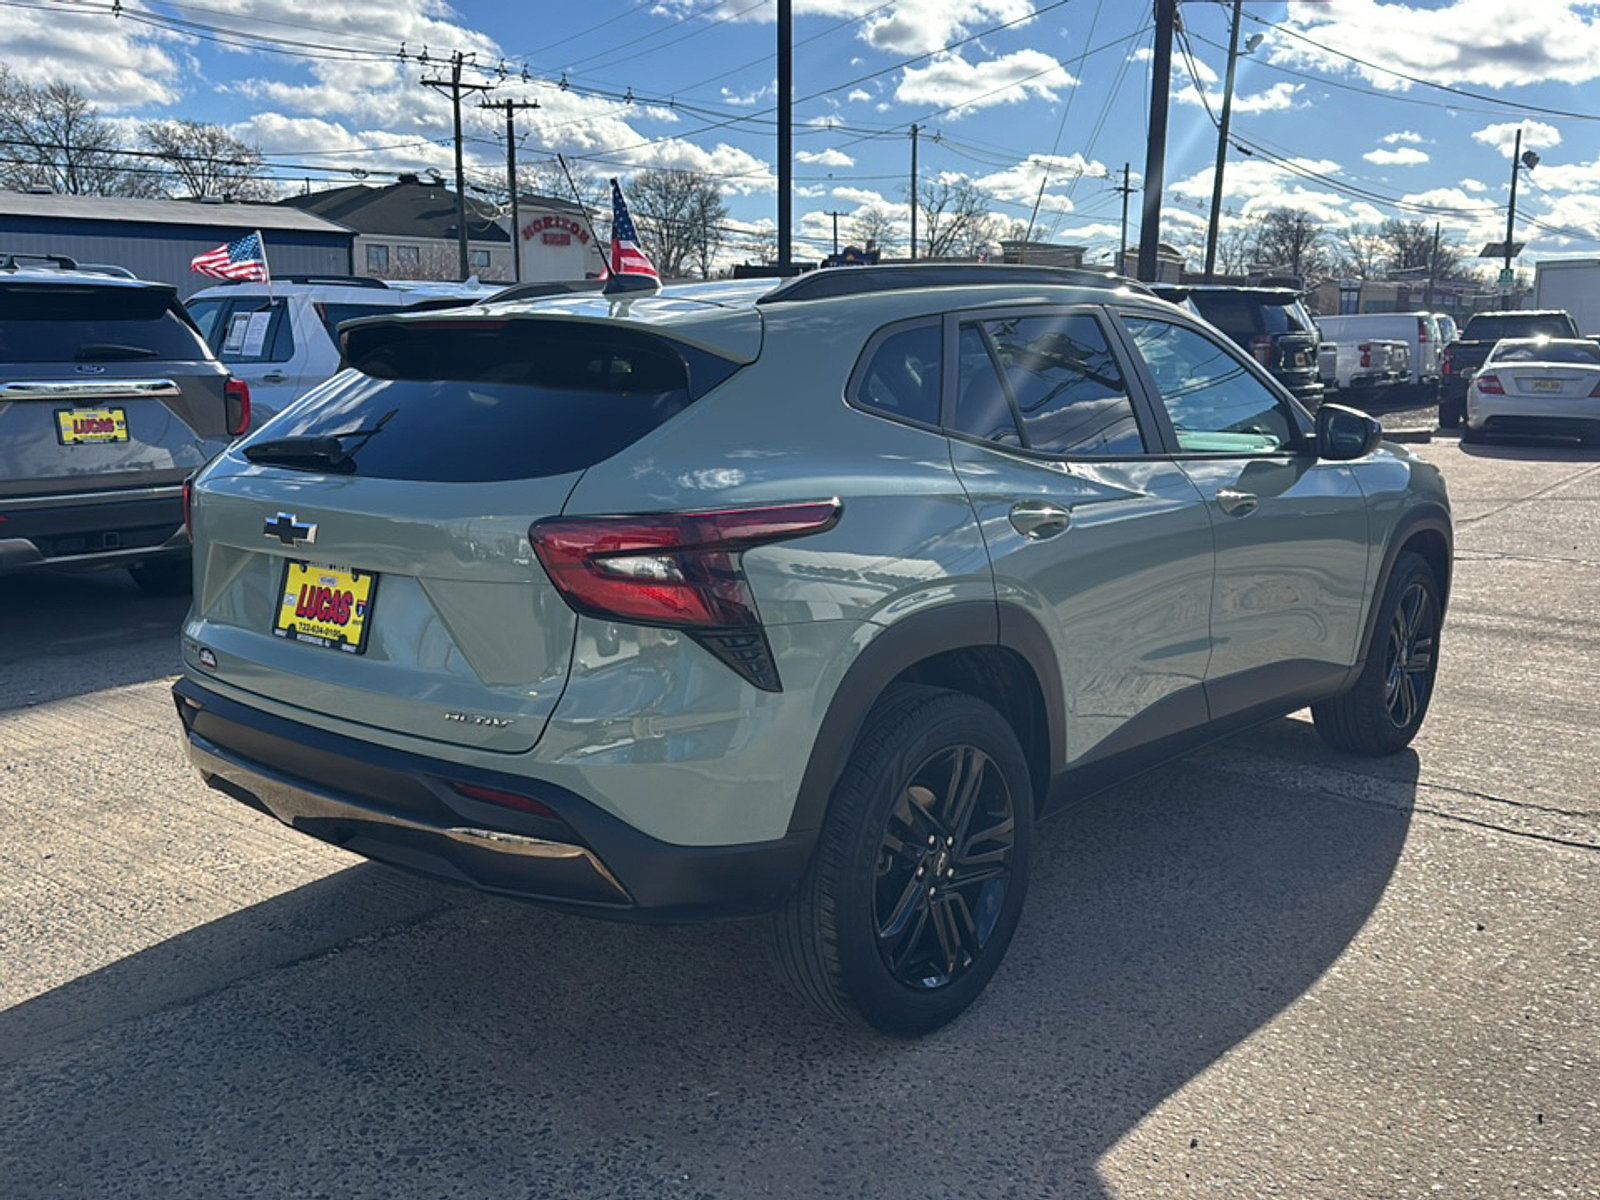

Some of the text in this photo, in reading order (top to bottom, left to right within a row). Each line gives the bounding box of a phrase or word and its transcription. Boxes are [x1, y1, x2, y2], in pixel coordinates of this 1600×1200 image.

[522, 215, 591, 245] HORIZON
[73, 417, 115, 435] LUCAS
[295, 584, 354, 627] LUCAS
